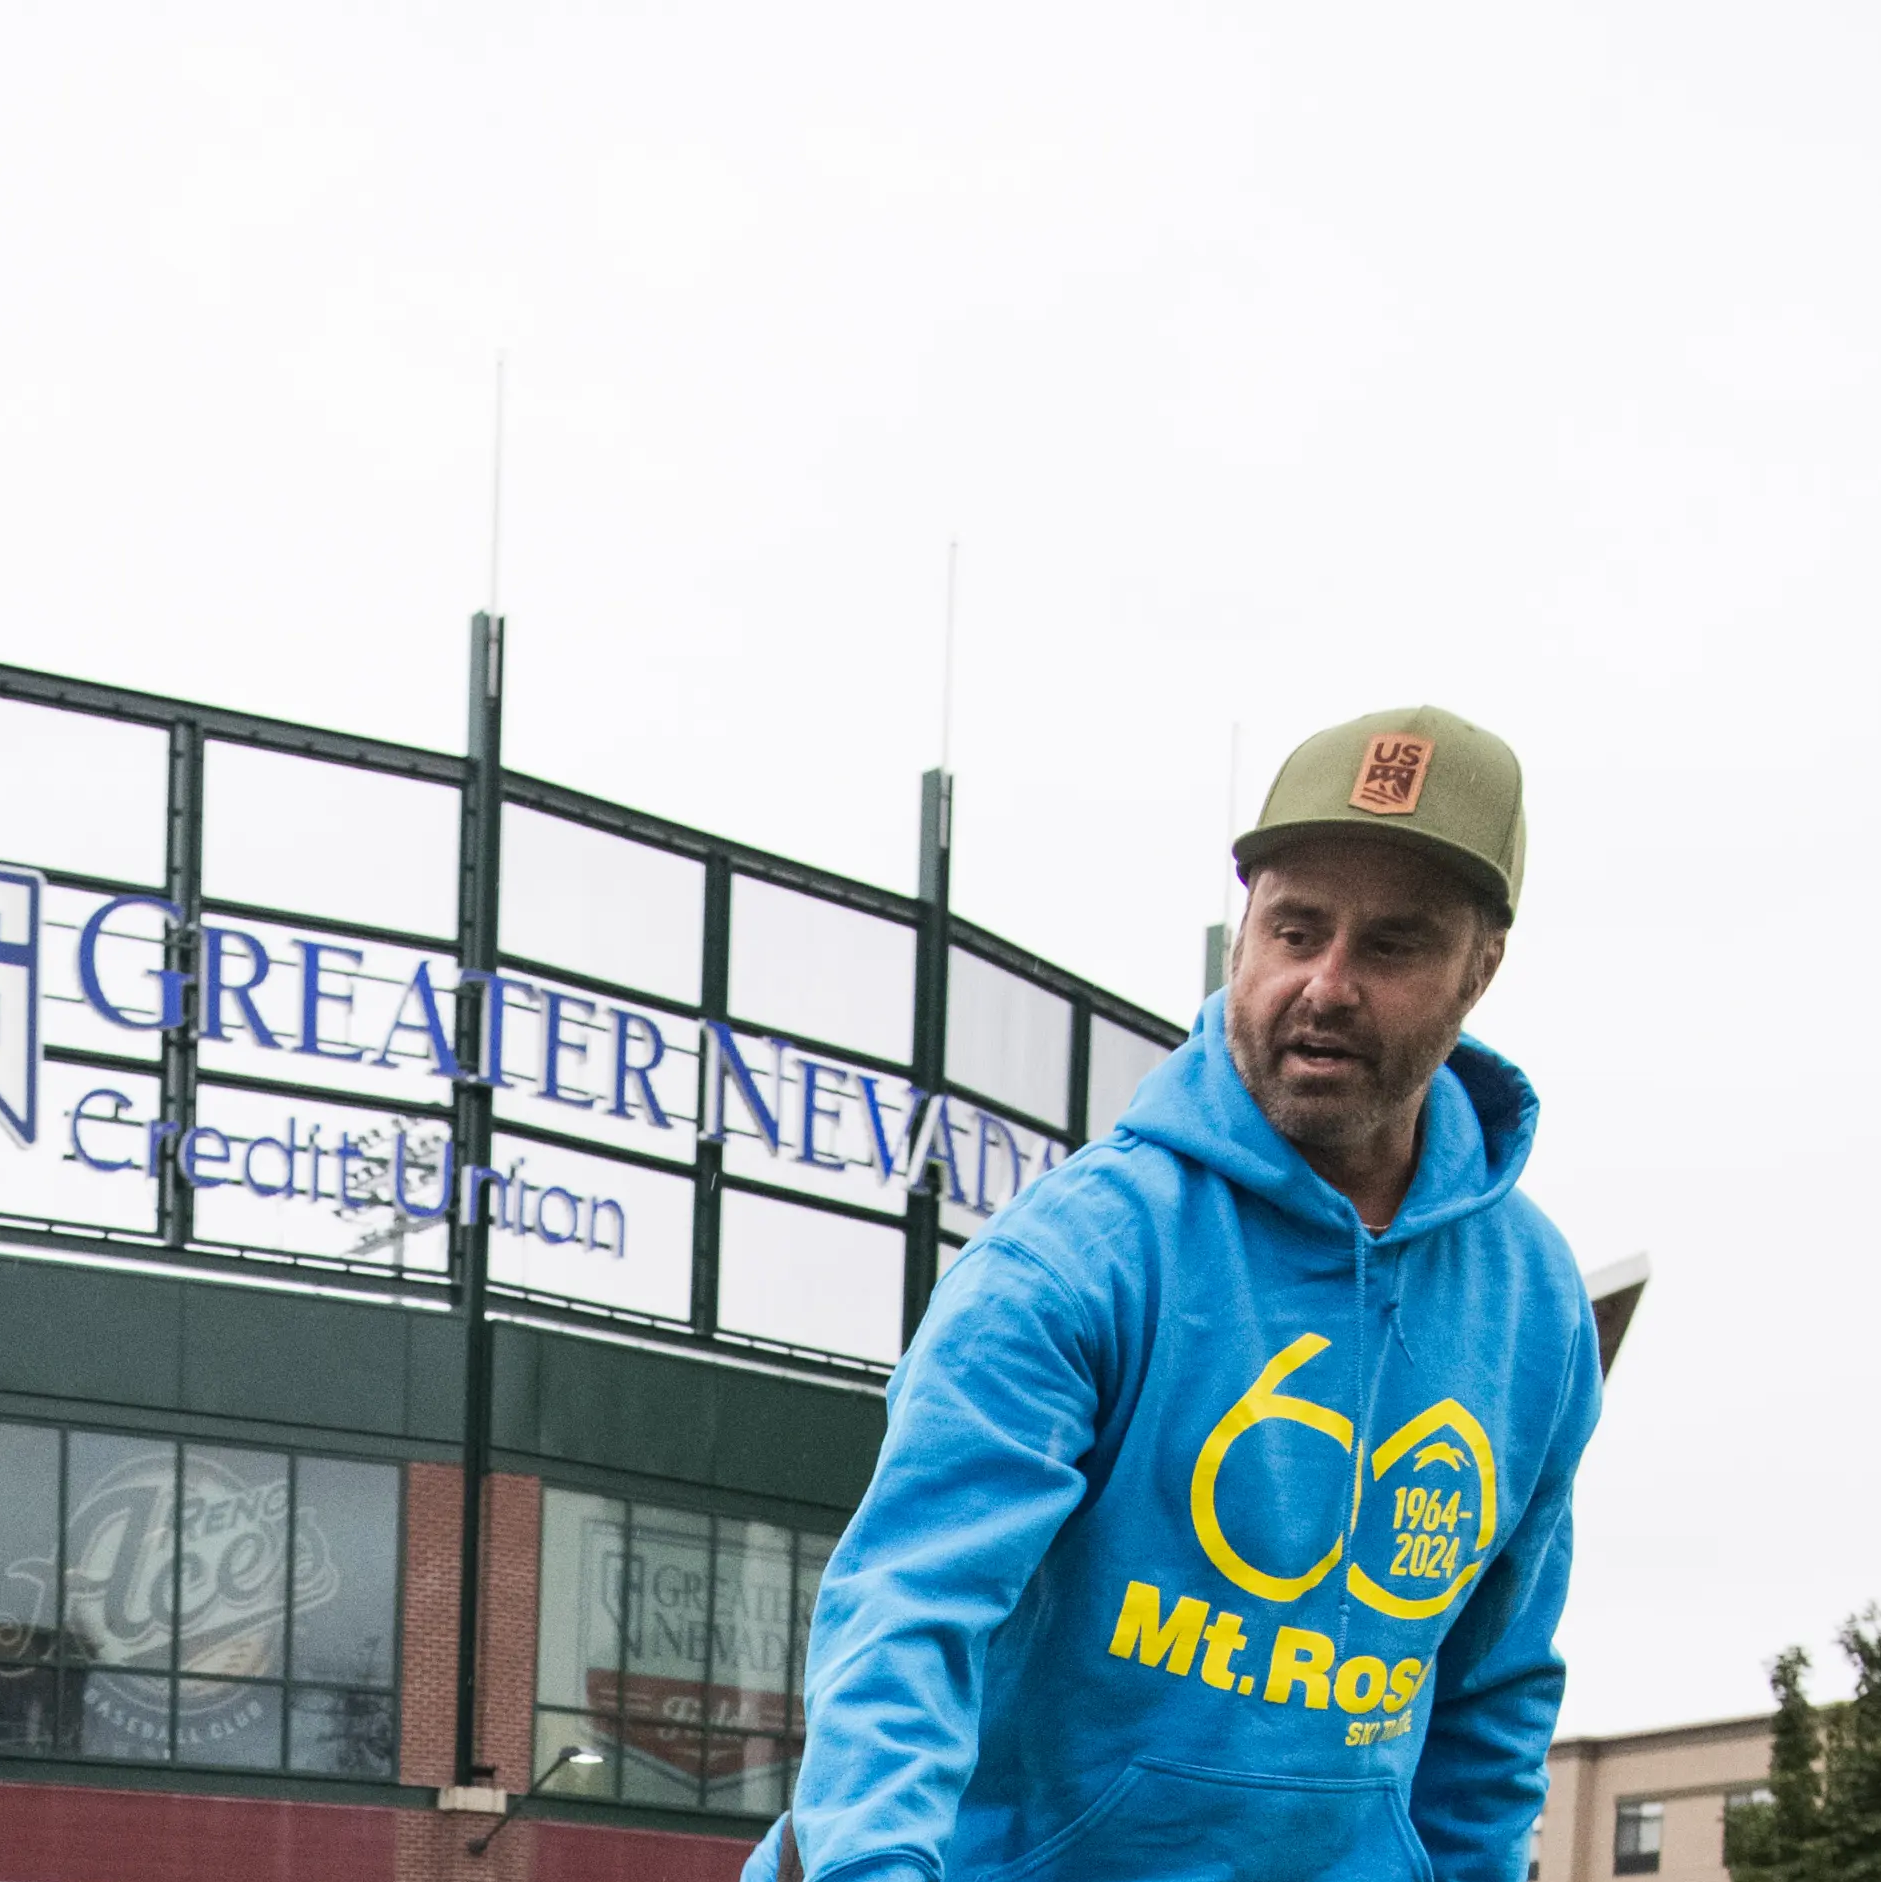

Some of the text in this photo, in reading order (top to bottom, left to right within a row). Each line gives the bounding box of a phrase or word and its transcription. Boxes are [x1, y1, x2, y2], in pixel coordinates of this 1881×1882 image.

[1374, 742, 1422, 766] US
[78, 894, 674, 1130] GREATER
[69, 1088, 626, 1260] Credit Union
[1389, 1533, 1460, 1580] 2024
[652, 1611, 798, 1673] NEVAD
[1263, 1626, 1434, 1715] Ros
